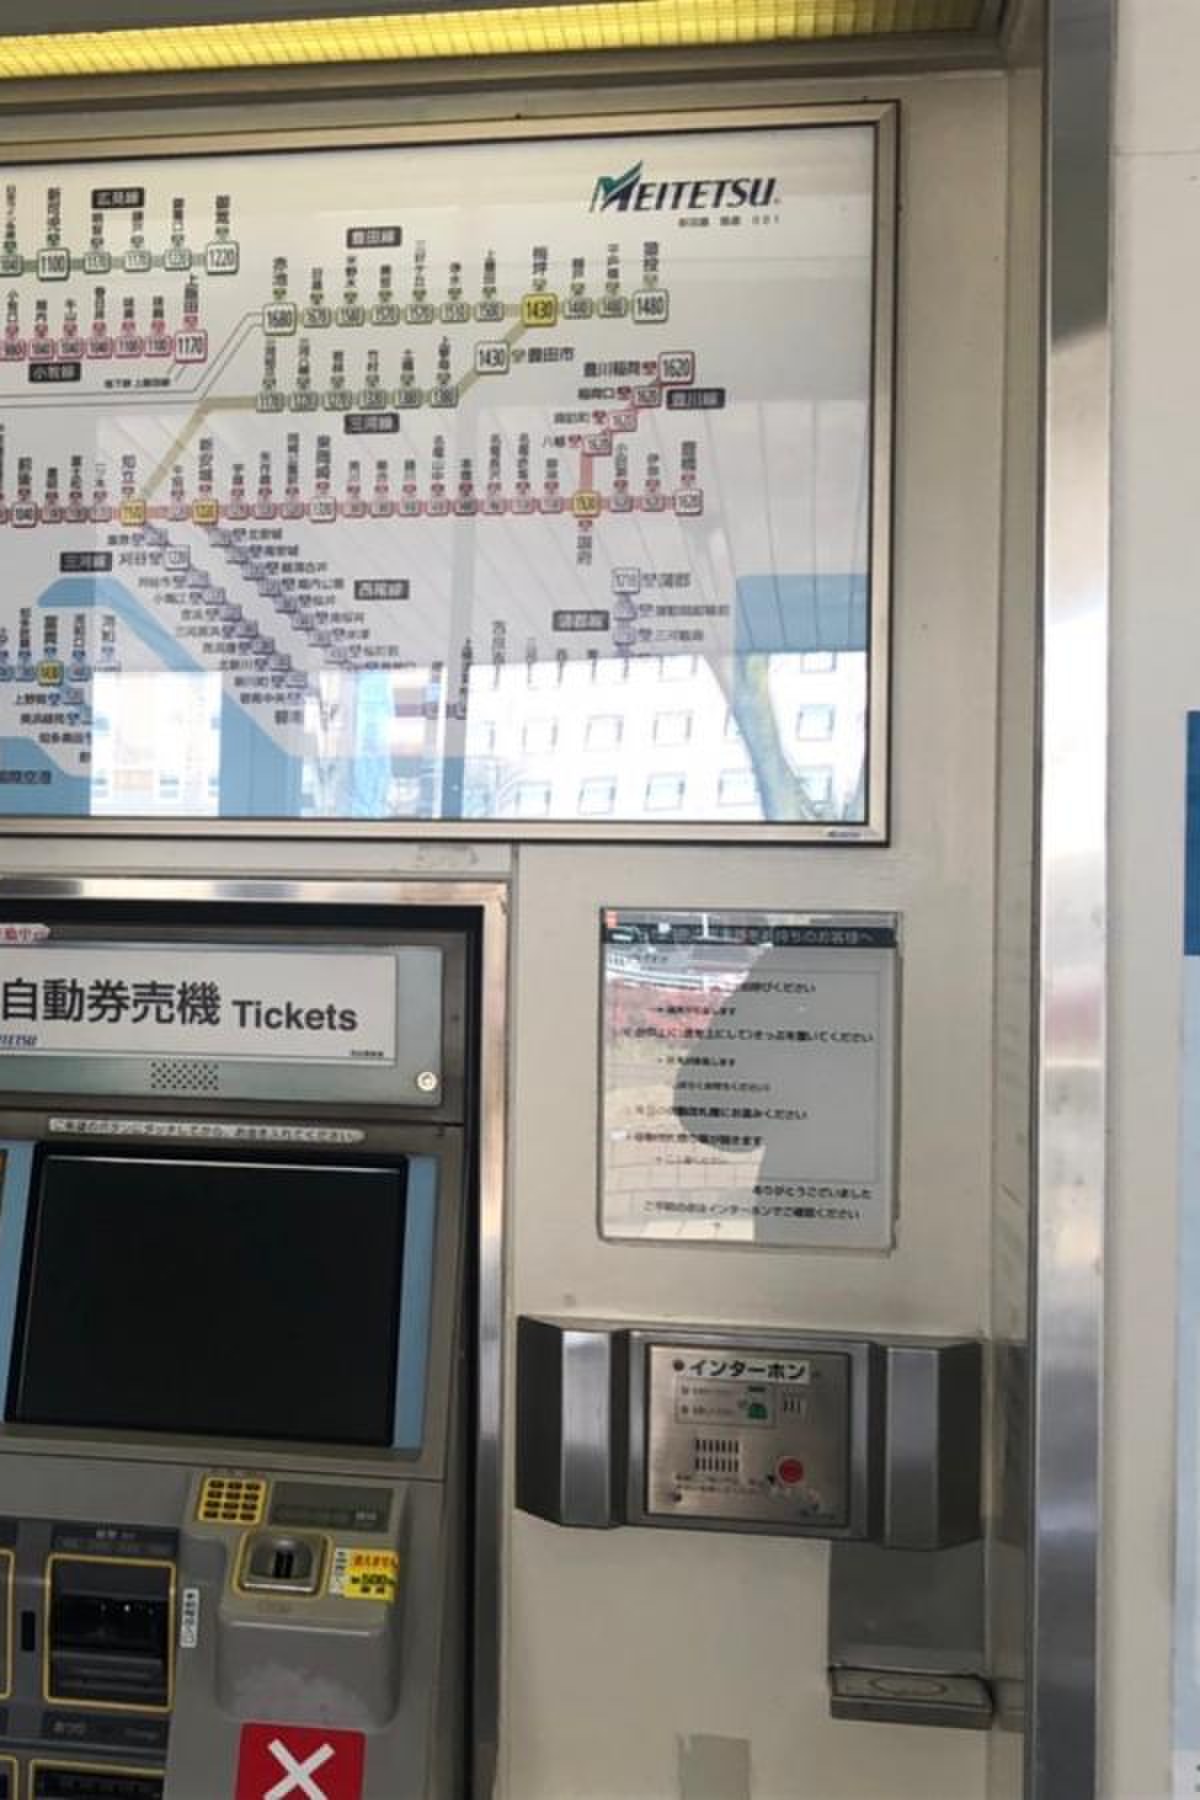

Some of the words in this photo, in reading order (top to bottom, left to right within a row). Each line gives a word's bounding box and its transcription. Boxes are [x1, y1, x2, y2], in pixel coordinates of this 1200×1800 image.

[590, 160, 777, 213] MEITETSU
[0, 979, 220, 1027] 自動券売機
[232, 999, 357, 1031] Tickets
[690, 1359, 806, 1379] インターホン
